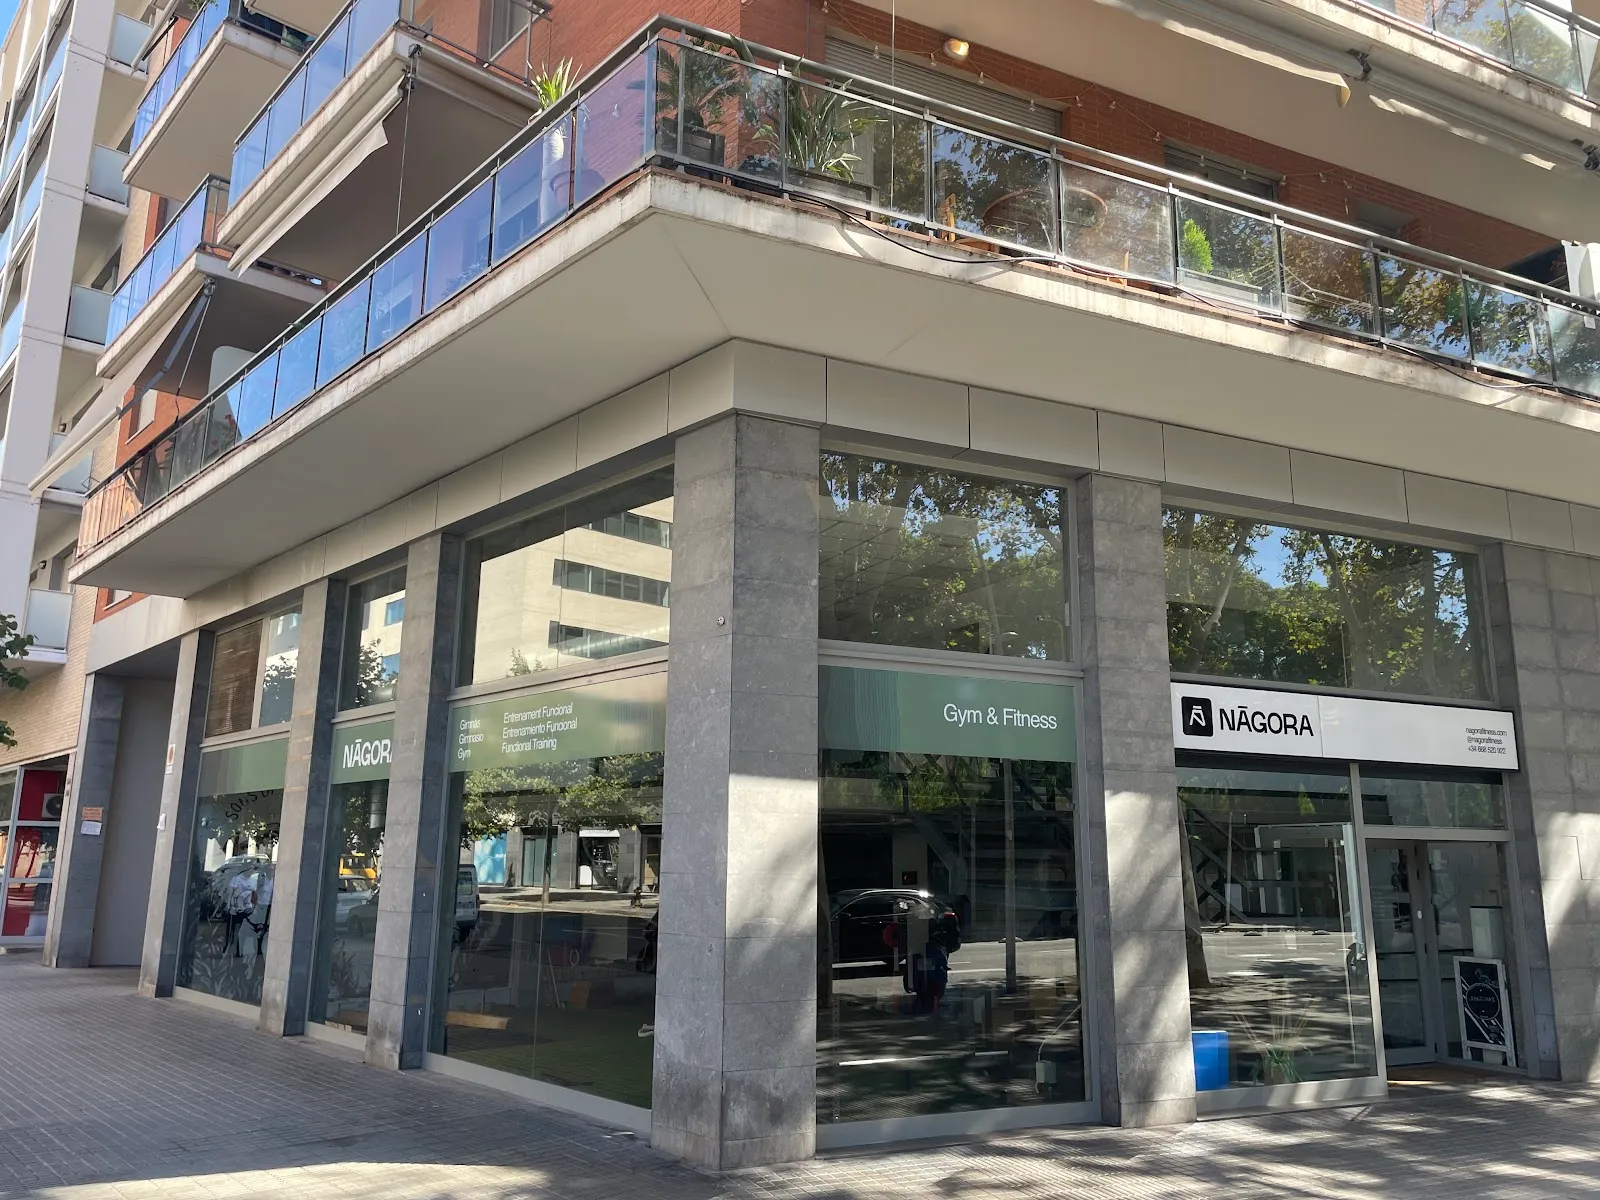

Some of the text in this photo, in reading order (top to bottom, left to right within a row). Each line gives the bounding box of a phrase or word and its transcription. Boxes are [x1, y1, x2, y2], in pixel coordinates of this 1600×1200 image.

[503, 702, 574, 724] Entrenament Funcional
[943, 703, 1058, 729] Gym & Fitness
[1219, 705, 1314, 736] NĀGORA
[459, 733, 484, 745] Gimnasio
[502, 717, 578, 739] Entrenamiento Funcional
[1466, 728, 1507, 736] nagorafitness.com
[342, 739, 393, 769] NĀGOR
[457, 748, 472, 761] Gym
[501, 736, 558, 754] Functional Training
